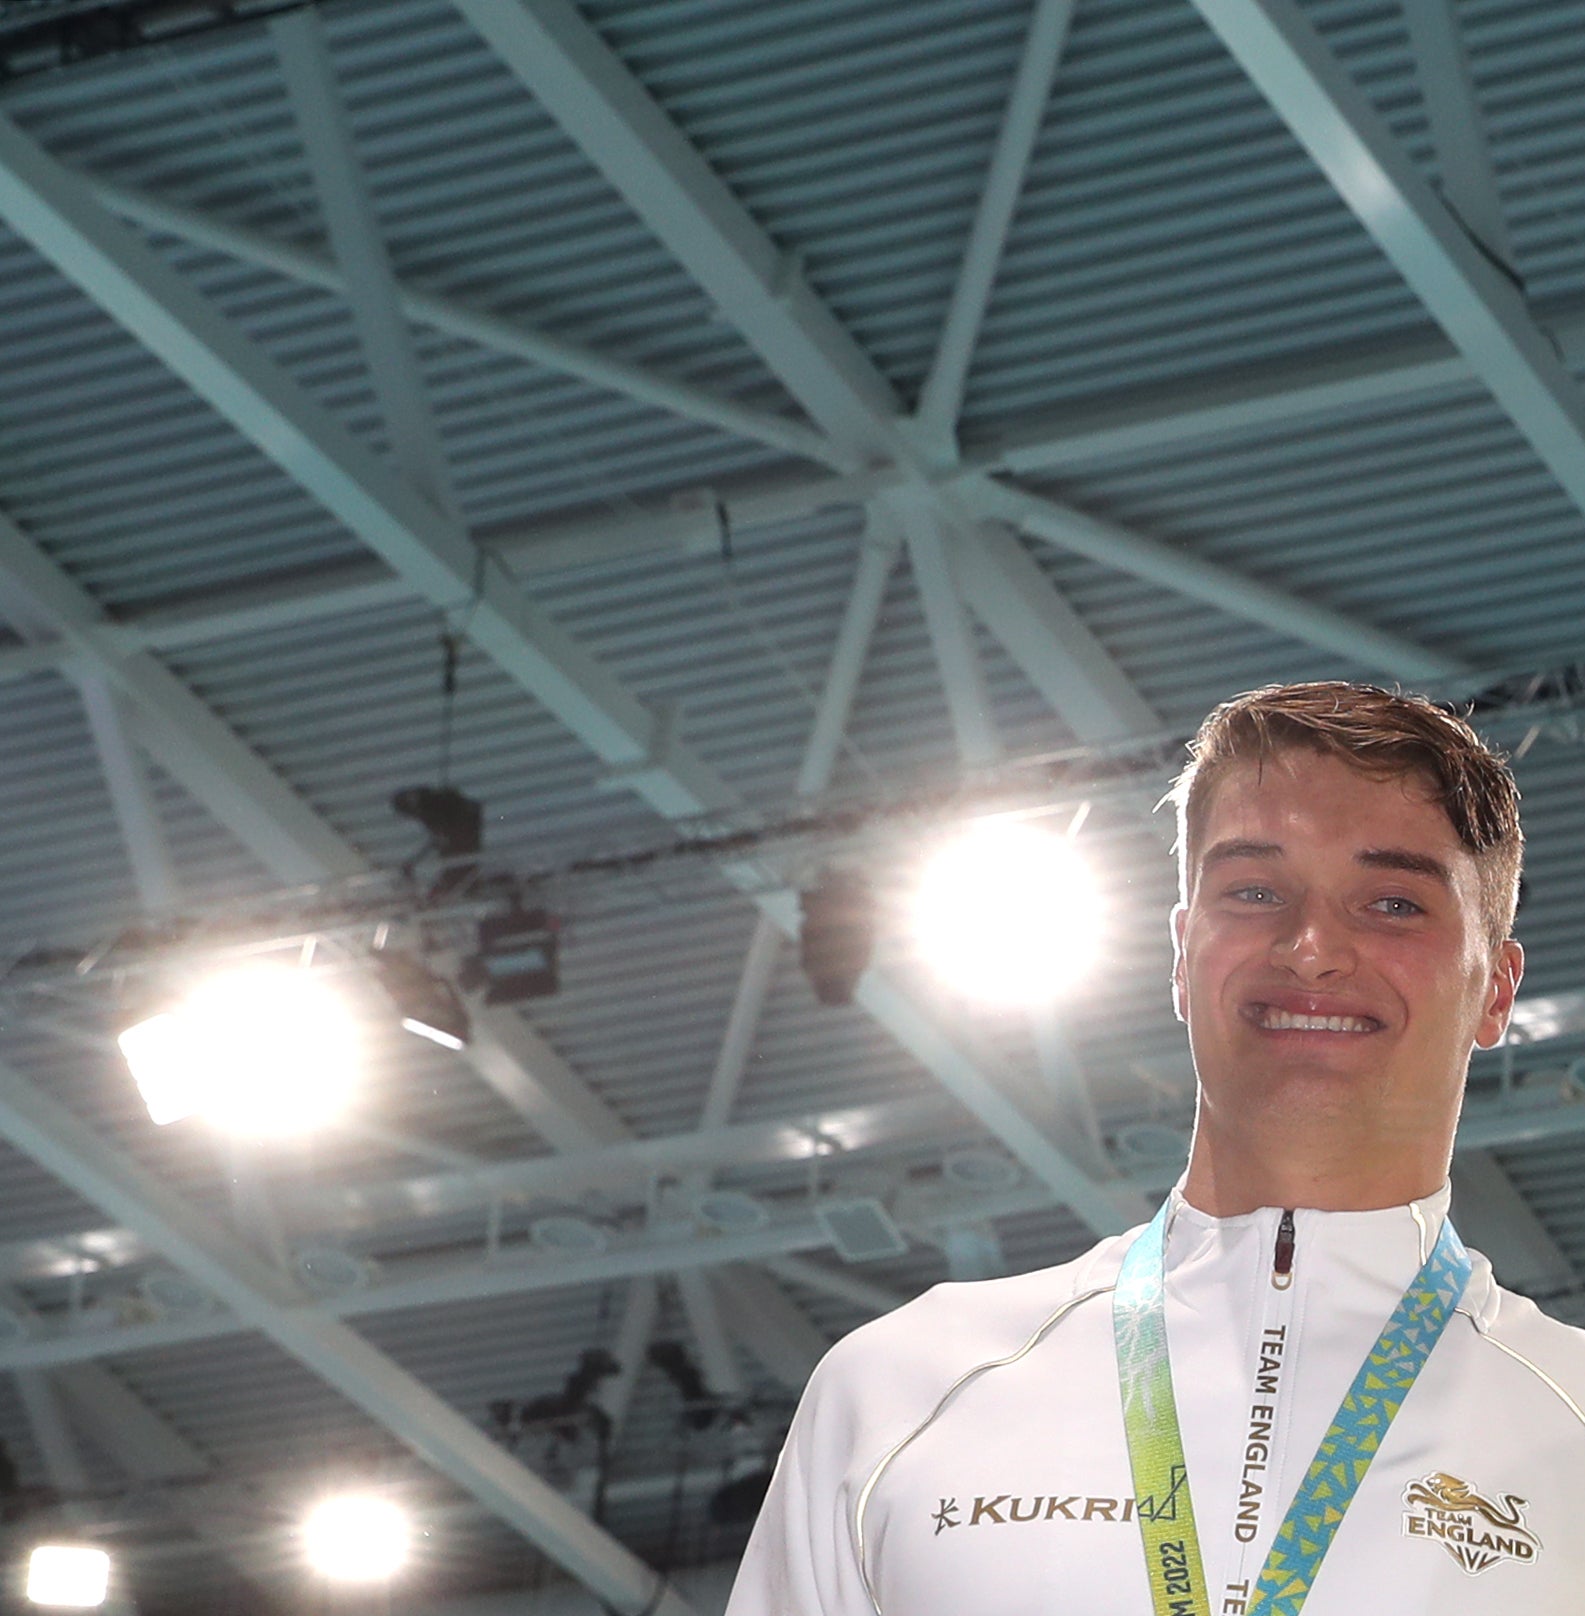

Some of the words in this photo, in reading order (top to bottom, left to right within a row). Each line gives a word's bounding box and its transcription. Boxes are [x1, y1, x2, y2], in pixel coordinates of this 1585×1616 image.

[1255, 1325, 1287, 1395] TEAM
[1233, 1404, 1275, 1543] ENGLAND
[968, 1494, 1137, 1526] KUKRI
[1424, 1507, 1472, 1526] TEAM
[1407, 1516, 1534, 1559] ENGLAND
[1159, 1540, 1194, 1596] 2022
